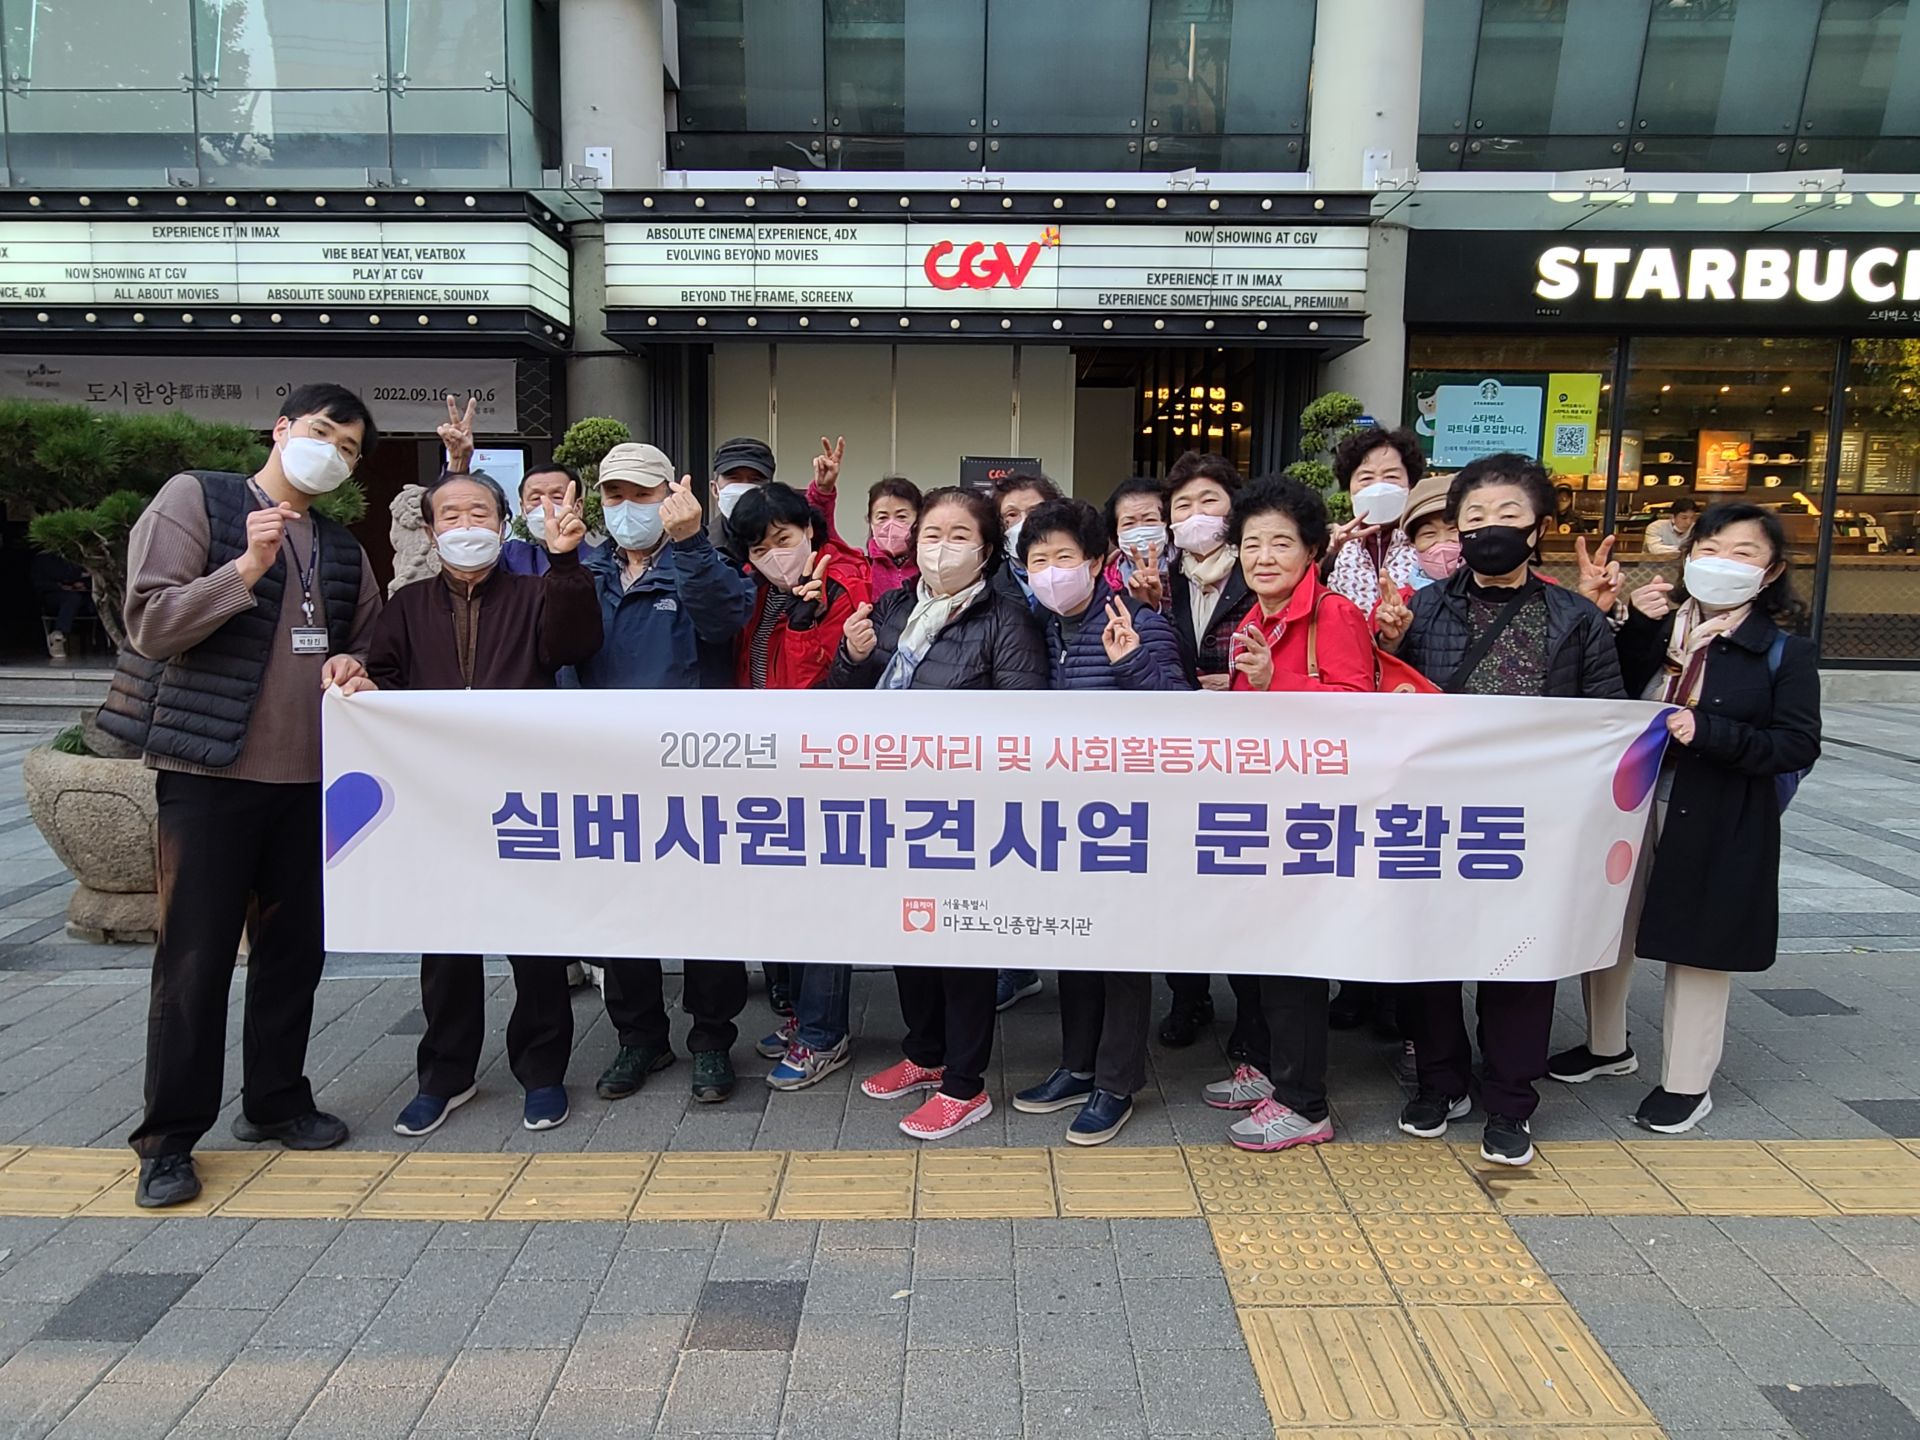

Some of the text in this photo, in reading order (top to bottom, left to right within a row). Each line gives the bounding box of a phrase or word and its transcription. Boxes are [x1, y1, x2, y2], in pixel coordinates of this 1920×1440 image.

[153, 226, 280, 239] EXPERIENCE IT IN IMAX
[647, 228, 857, 242] ABSOLUTE CINEMA EXPERIENCE, 4DX
[1185, 231, 1318, 244] NOW SHOWING AT CGV
[322, 248, 466, 261] VIBE BEAT VEAT, VEATBOX
[666, 249, 819, 261] EVOLVING BEYOND MOVIES
[924, 240, 1041, 290] CGV
[65, 268, 187, 279] NOW SHOWING AT CGV
[353, 269, 423, 280] PLAY AT CGV
[1147, 273, 1282, 286] EXPERIENCE IT IN IMAX
[24, 287, 46, 298] 4DX
[114, 288, 219, 300] ALL ABOUT MOVIES
[267, 289, 489, 303] ABSOLUTE SOUND EXPERIENCE, SOUNDX
[681, 290, 853, 304] BEYOND THE FRAME, SCREENX
[1099, 294, 1349, 309] EXPERIENCE SOMETHING SPECIAL, PREMIUM
[1867, 310, 1909, 321] 스타벅스
[1471, 415, 1505, 423] 스타벅스
[1447, 424, 1527, 435] 파트너를 모집합니다.
[660, 732, 1349, 775] 2022년 노인일자리 및 사회활동지원사업
[491, 791, 1526, 880] 실버사원파견사업 문화활동
[942, 899, 988, 910] 서울특별시
[943, 914, 1092, 936] 마포노인종합복지관
